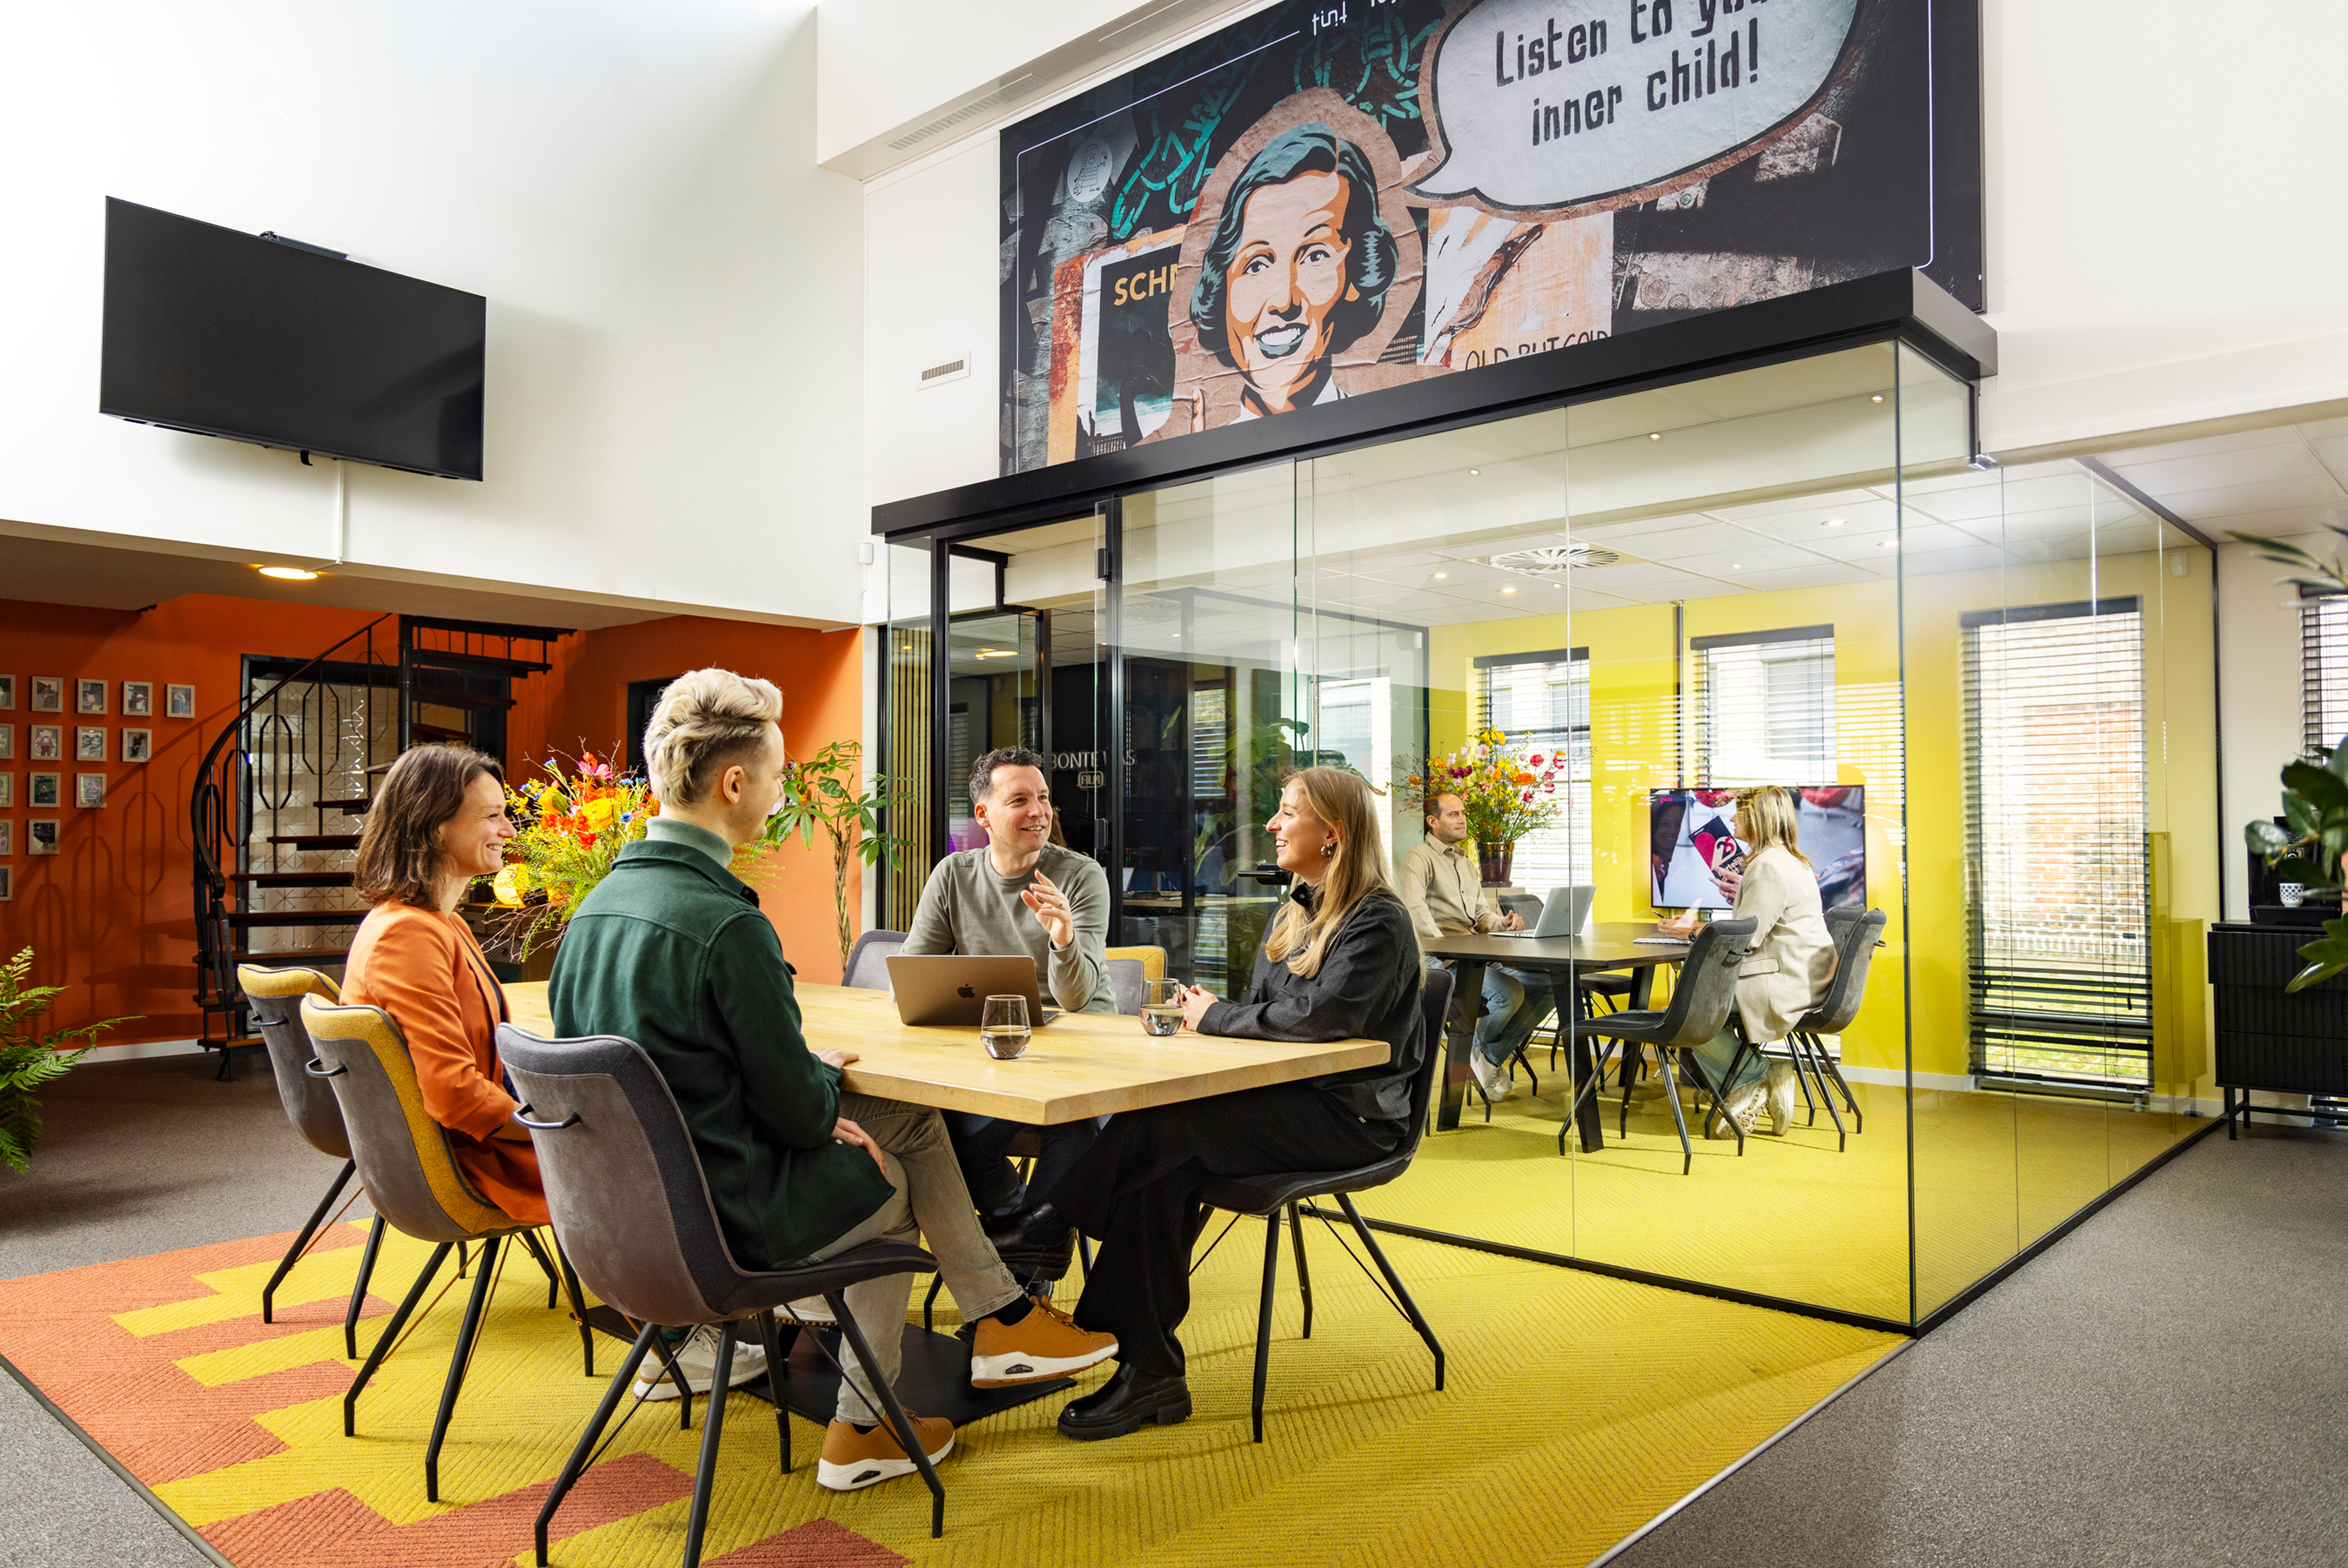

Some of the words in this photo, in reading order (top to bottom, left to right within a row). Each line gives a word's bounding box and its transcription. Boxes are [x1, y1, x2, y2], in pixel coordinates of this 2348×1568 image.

[1496, 17, 1607, 87] Listen
[1630, 0, 1673, 44] to
[1532, 84, 1622, 146] inner
[1647, 17, 1758, 111] child!
